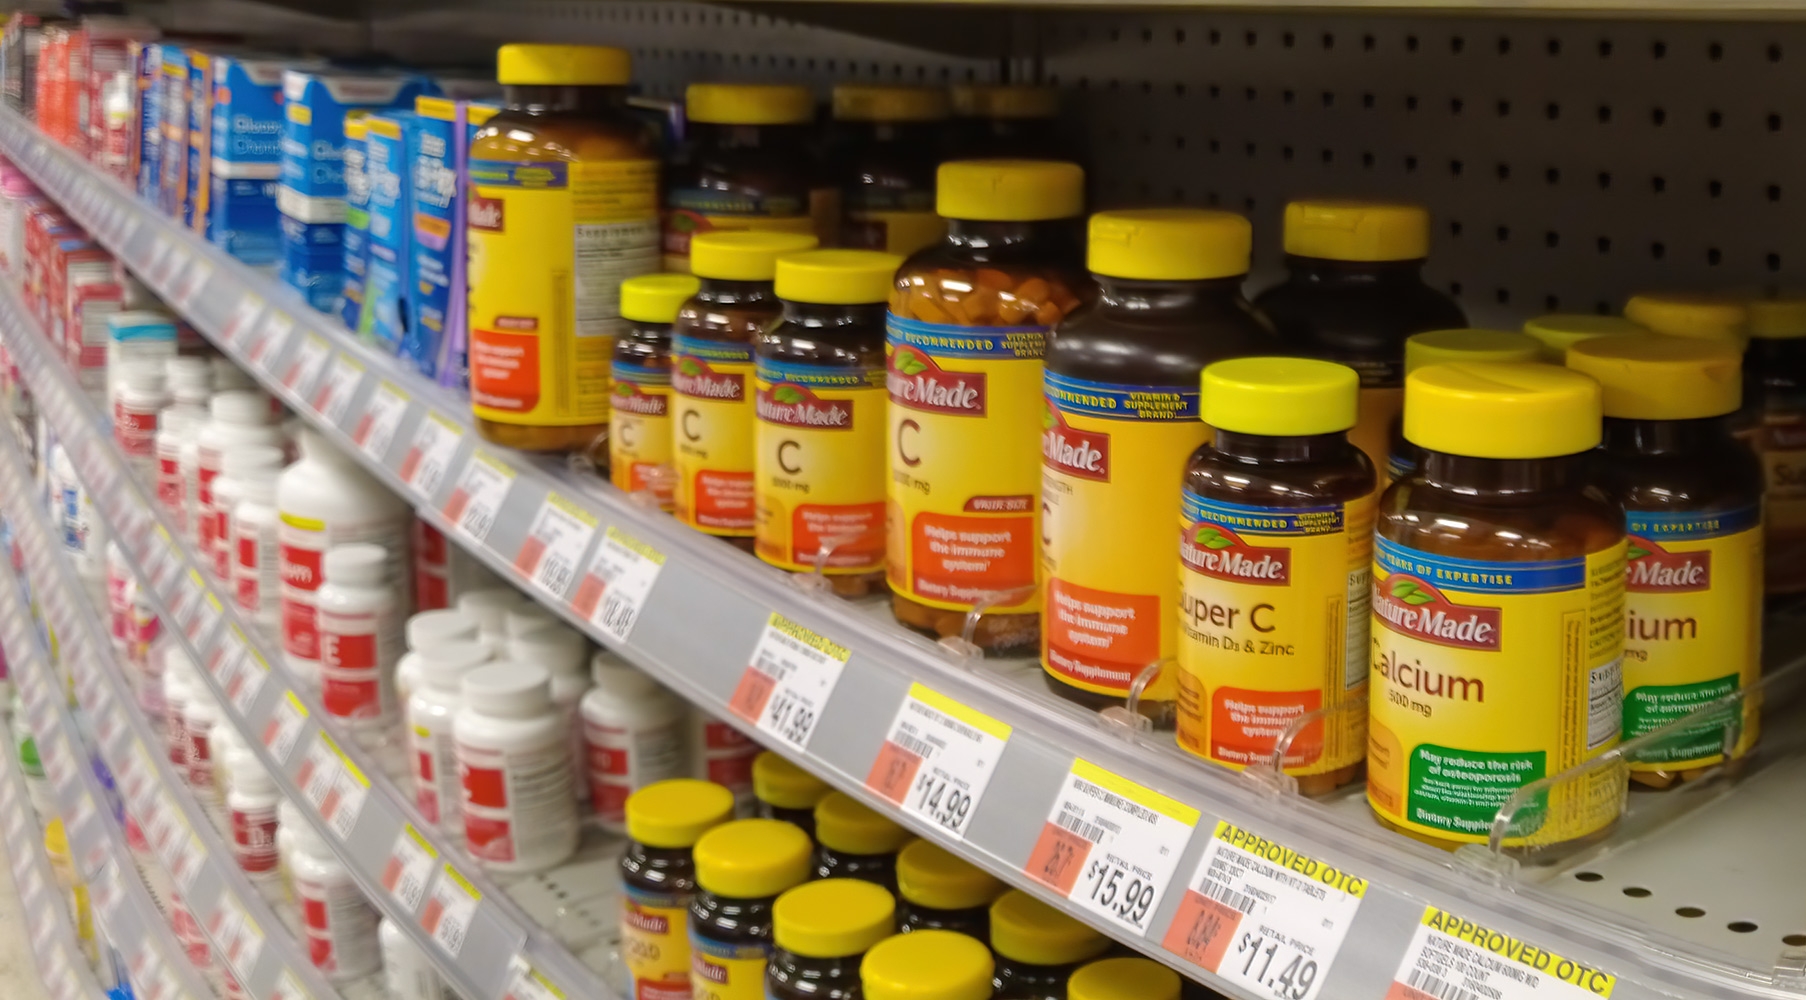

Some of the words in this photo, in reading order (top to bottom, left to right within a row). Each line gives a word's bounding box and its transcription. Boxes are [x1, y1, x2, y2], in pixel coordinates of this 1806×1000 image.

[916, 773, 972, 829] $14.99
[1088, 860, 1155, 923] $15.99
[1220, 824, 1317, 886] APPROVED
[1321, 869, 1362, 895] OTC
[1238, 932, 1318, 1000] $11.49
